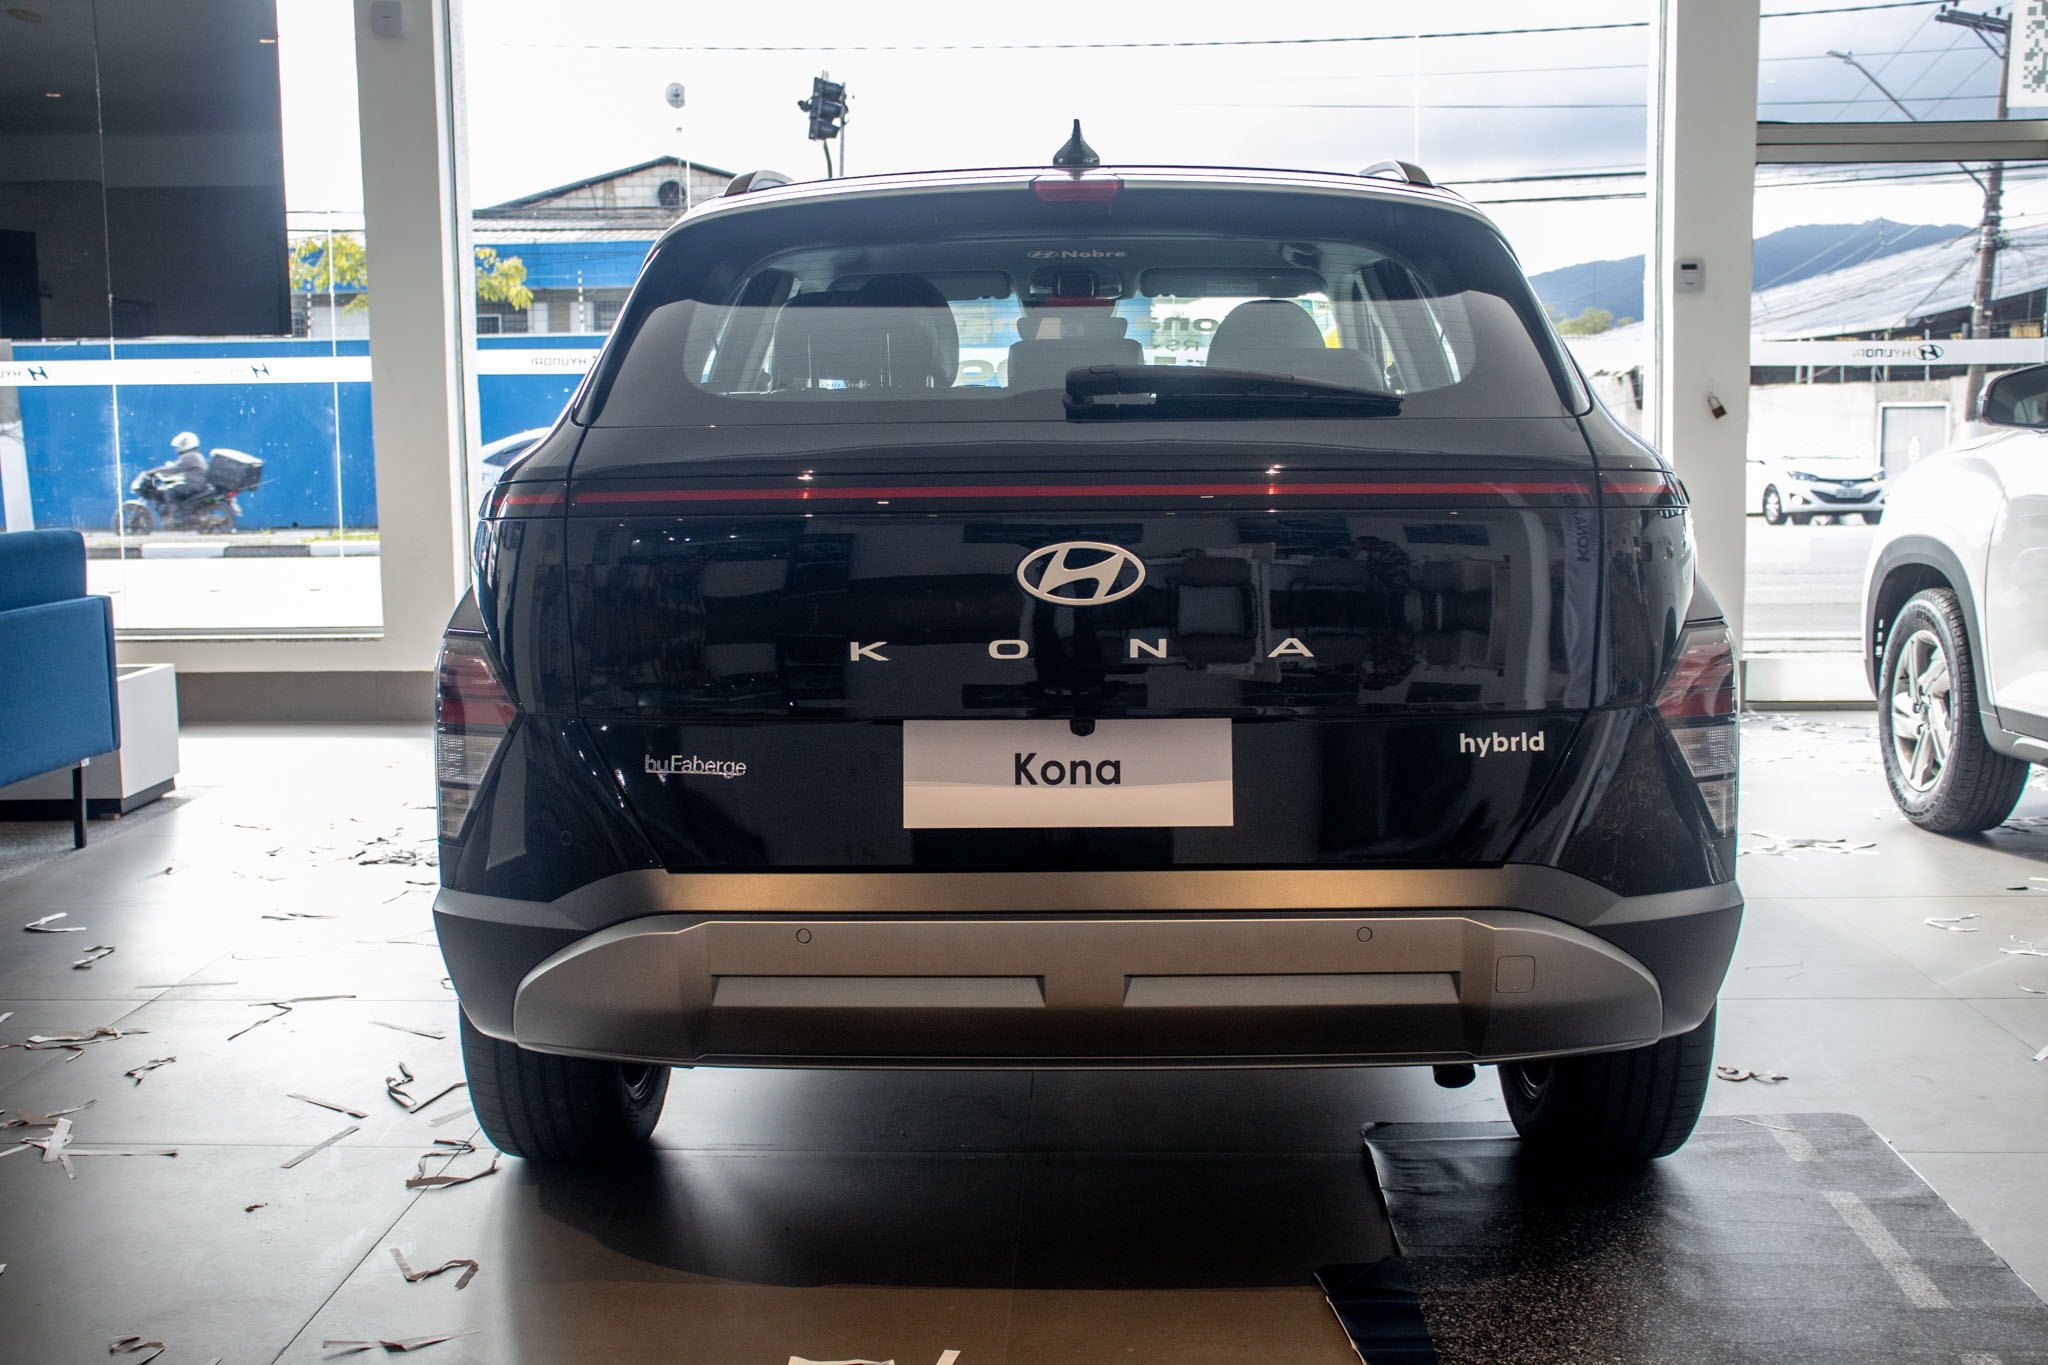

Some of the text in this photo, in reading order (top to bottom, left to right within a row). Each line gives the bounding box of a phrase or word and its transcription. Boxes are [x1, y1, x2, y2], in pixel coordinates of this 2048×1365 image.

[1061, 249, 1126, 258] Nobre
[849, 637, 1315, 662] KONA
[1014, 752, 1121, 786] Kona
